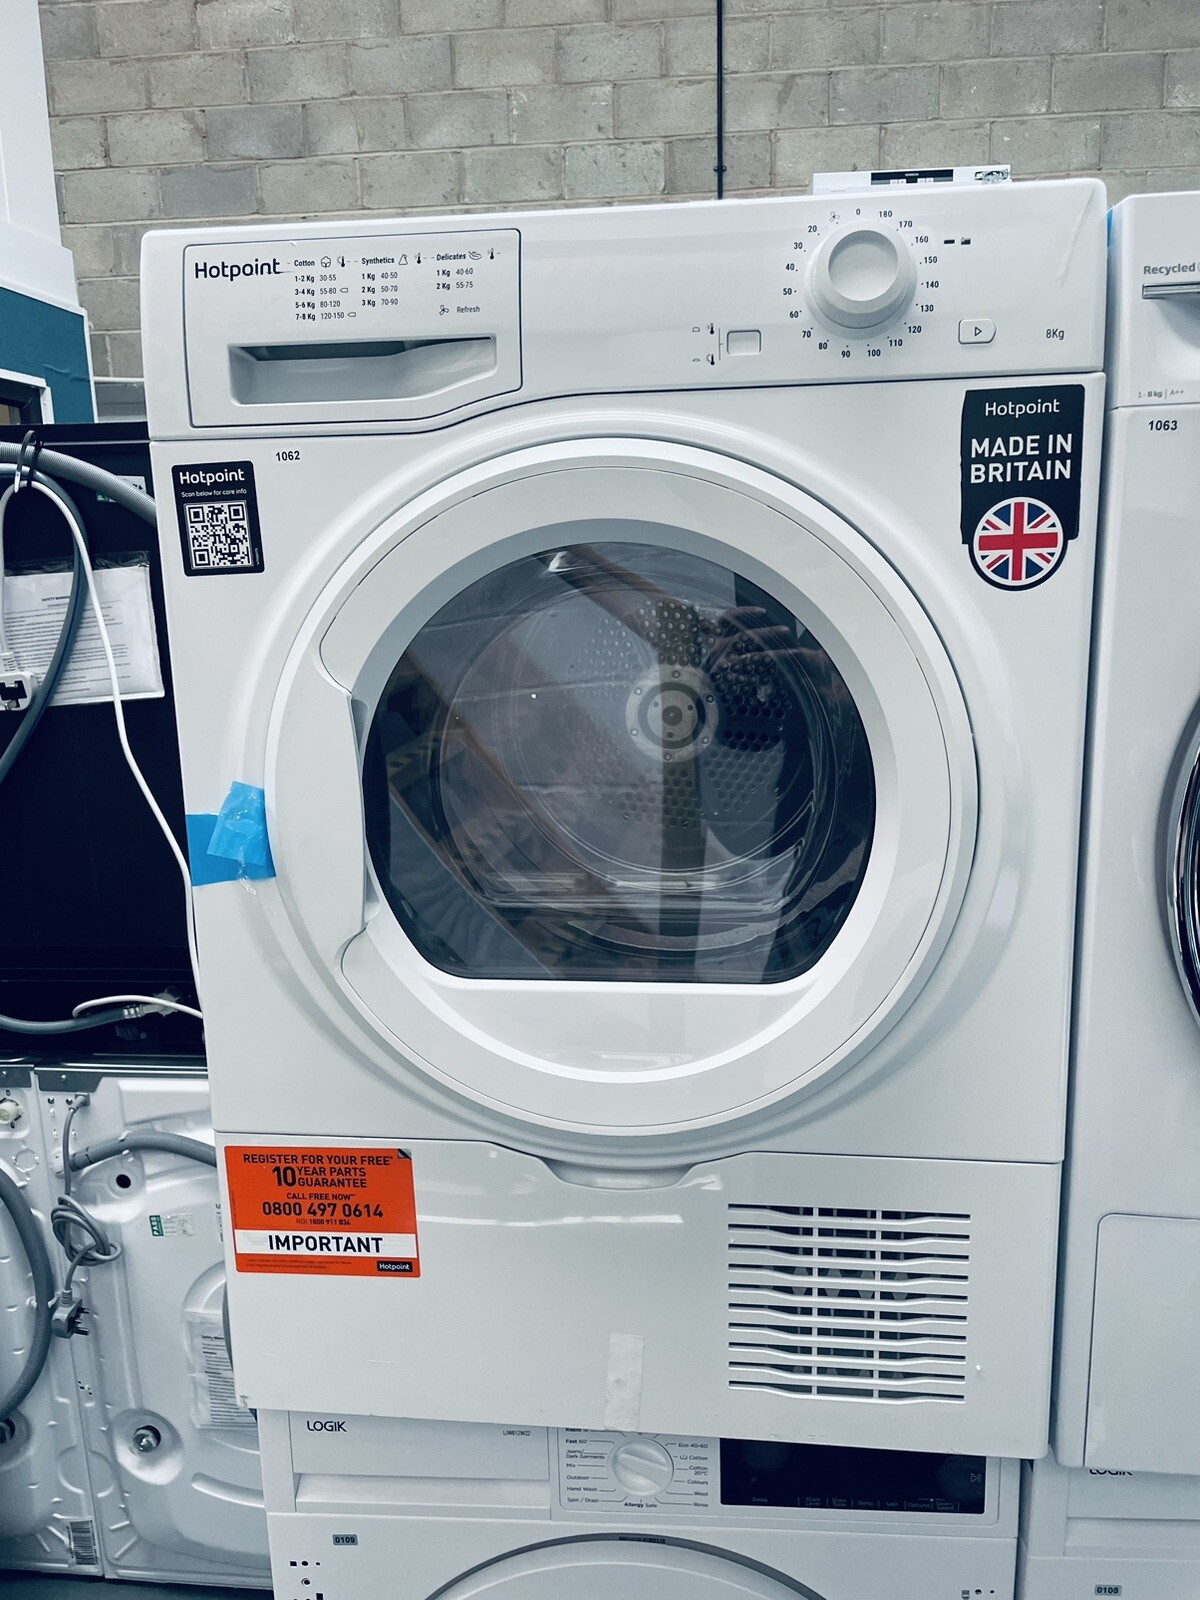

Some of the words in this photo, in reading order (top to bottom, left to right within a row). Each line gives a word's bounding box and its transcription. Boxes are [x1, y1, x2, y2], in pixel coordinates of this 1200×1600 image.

[878, 210, 893, 218] 180
[898, 220, 913, 228] 170
[808, 225, 817, 233] 20
[914, 235, 928, 244] 160
[793, 242, 803, 250] 30
[362, 257, 394, 266] Synthetics
[436, 253, 466, 261] Delicates
[923, 256, 937, 264] 150
[194, 258, 281, 281] Hotpoint
[785, 263, 795, 271] 40
[1143, 263, 1195, 276] Recycled
[307, 275, 314, 283] Kg
[367, 273, 375, 281] Kg
[925, 280, 939, 289] 140
[307, 288, 315, 296] Kg
[367, 286, 375, 294] Kg
[307, 301, 315, 309] Kg
[920, 304, 934, 313] 130
[308, 313, 316, 321] Kg
[802, 330, 811, 338] 70
[907, 325, 922, 334] 120
[1045, 328, 1064, 340] 8Kg
[818, 342, 828, 350] 80
[889, 338, 903, 347] 110
[841, 350, 851, 358] 90
[867, 349, 881, 357] 100
[985, 399, 1060, 419] Hotpoint
[1148, 420, 1178, 431] 1063
[971, 435, 1040, 458] MADE
[1048, 434, 1072, 454] IN
[276, 451, 300, 461] 1062
[970, 459, 1071, 484] BRITAIN
[180, 469, 245, 486] Hotpoint
[243, 1154, 298, 1164] REGISTER
[302, 1155, 324, 1164] FOR
[326, 1156, 357, 1165] YOUR
[297, 1167, 326, 1176] YEAR
[329, 1167, 366, 1176] PARTS
[272, 1166, 296, 1187] 10
[298, 1177, 367, 1188] GUARANTEE
[262, 1202, 302, 1216] 0800
[308, 1203, 337, 1216] 497
[342, 1203, 383, 1218] 0614
[268, 1235, 383, 1253] IMPORTANT
[307, 1421, 346, 1432] LOGIK
[335, 1536, 355, 1544] 0109
[1096, 1586, 1118, 1595] 0108
